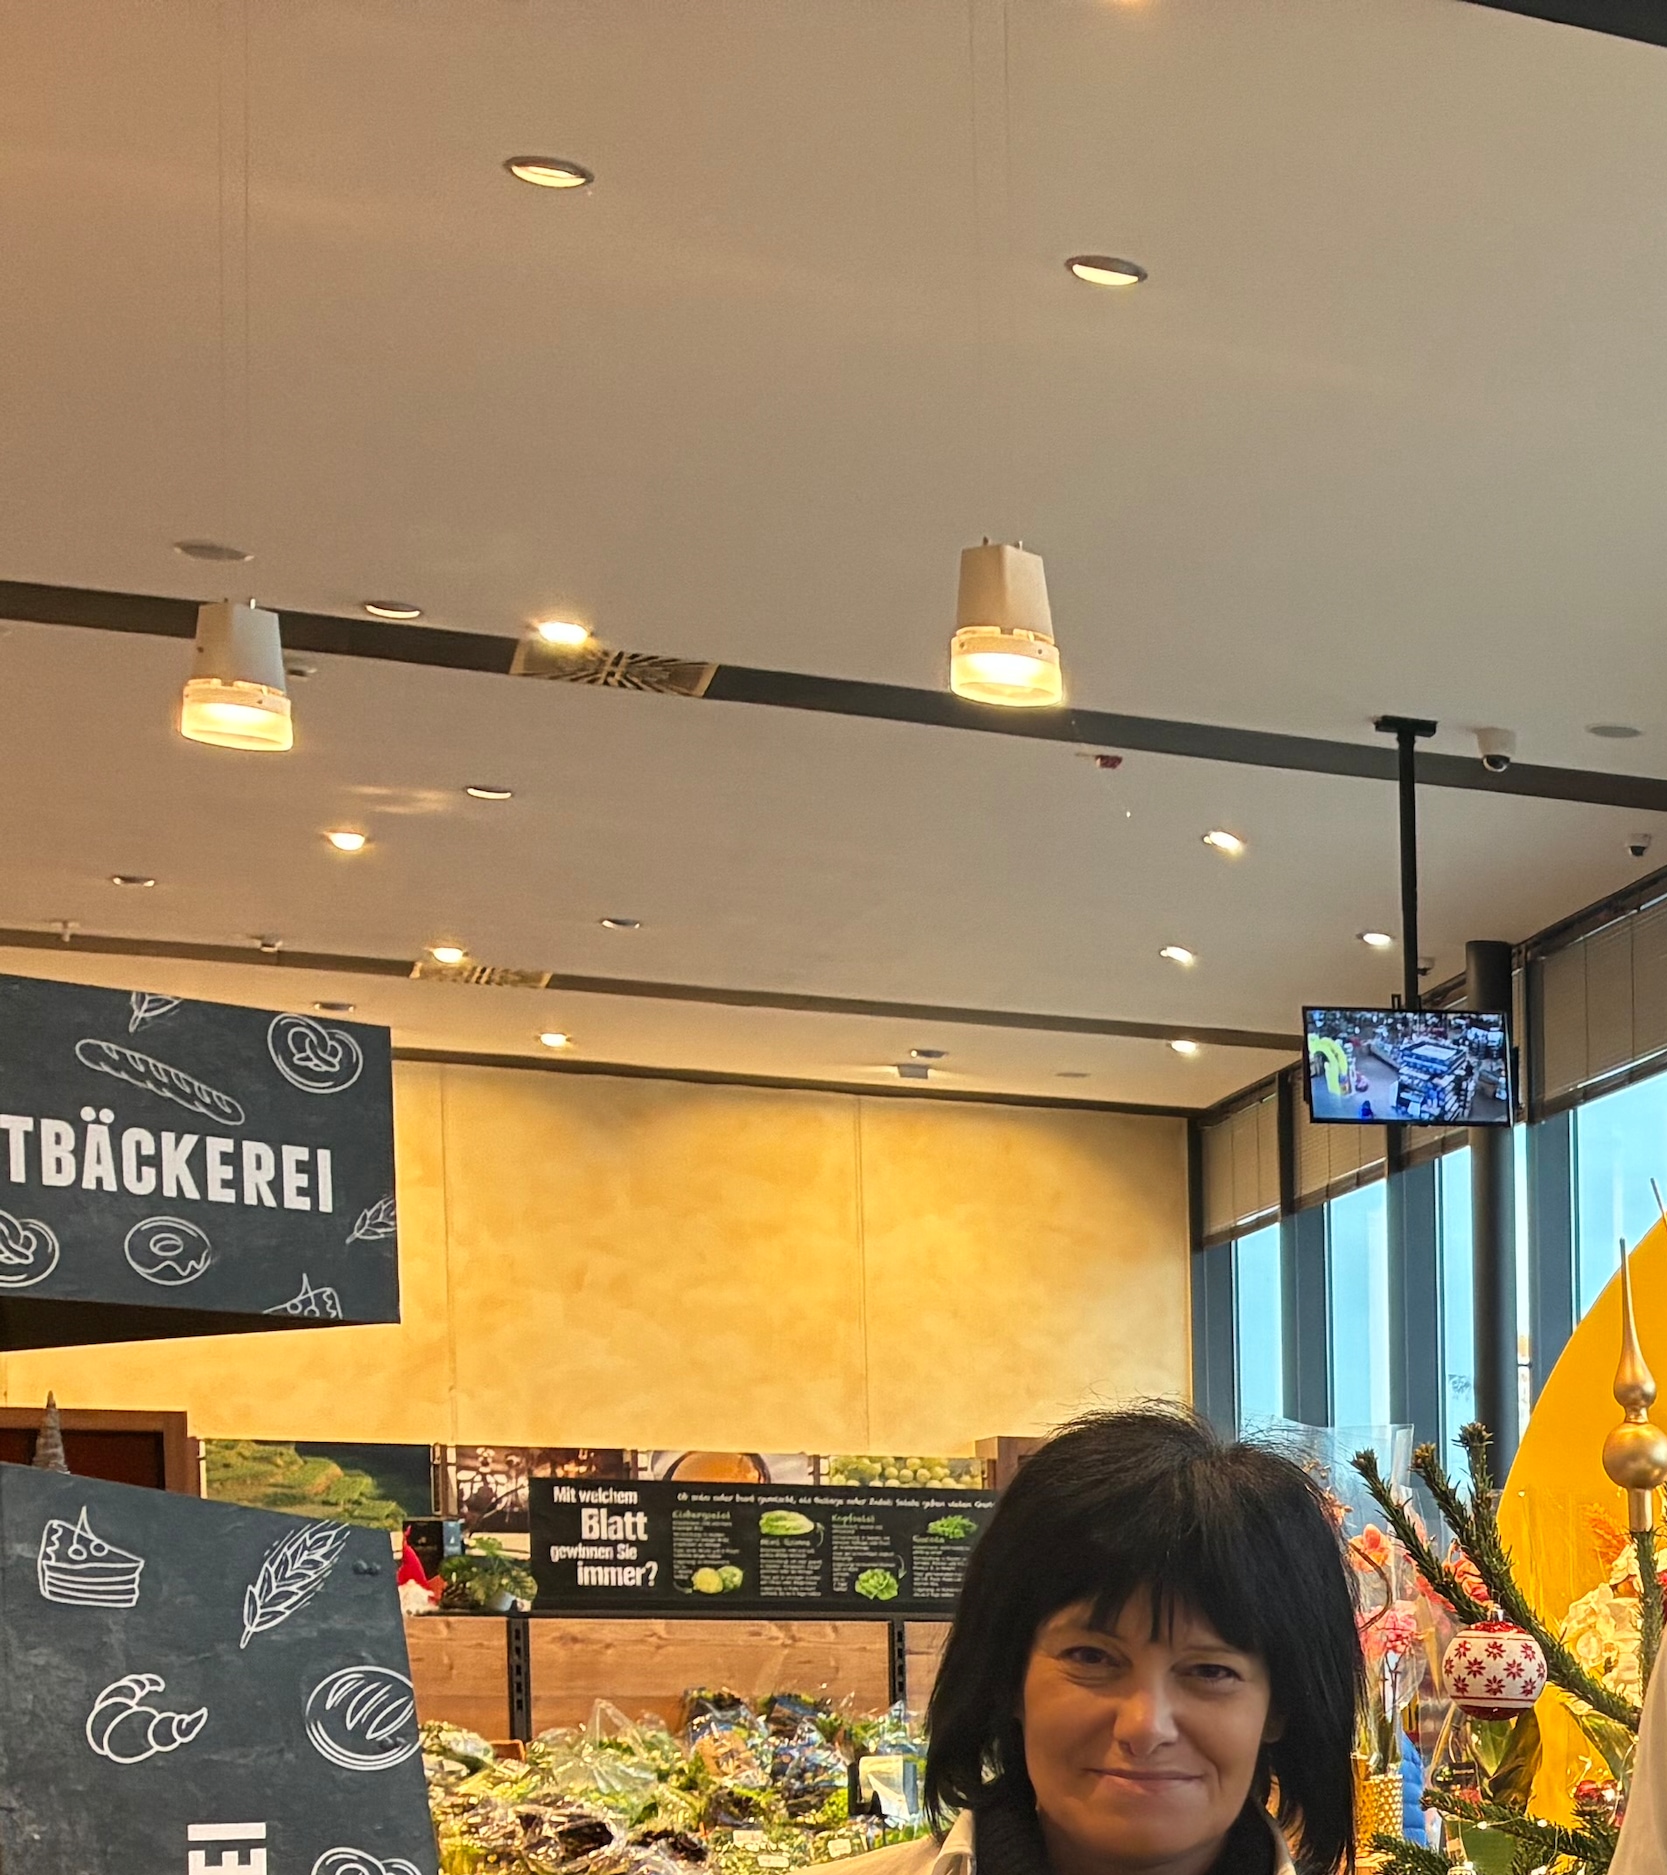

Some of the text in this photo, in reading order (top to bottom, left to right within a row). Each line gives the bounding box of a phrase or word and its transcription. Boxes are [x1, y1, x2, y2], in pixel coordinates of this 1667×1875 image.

[0, 1106, 333, 1213] TBÄCKEREI
[553, 1486, 638, 1505] Mit welchem
[581, 1508, 648, 1541] Blatt
[550, 1543, 638, 1562] gewinnen Sie
[577, 1561, 658, 1587] immer?
